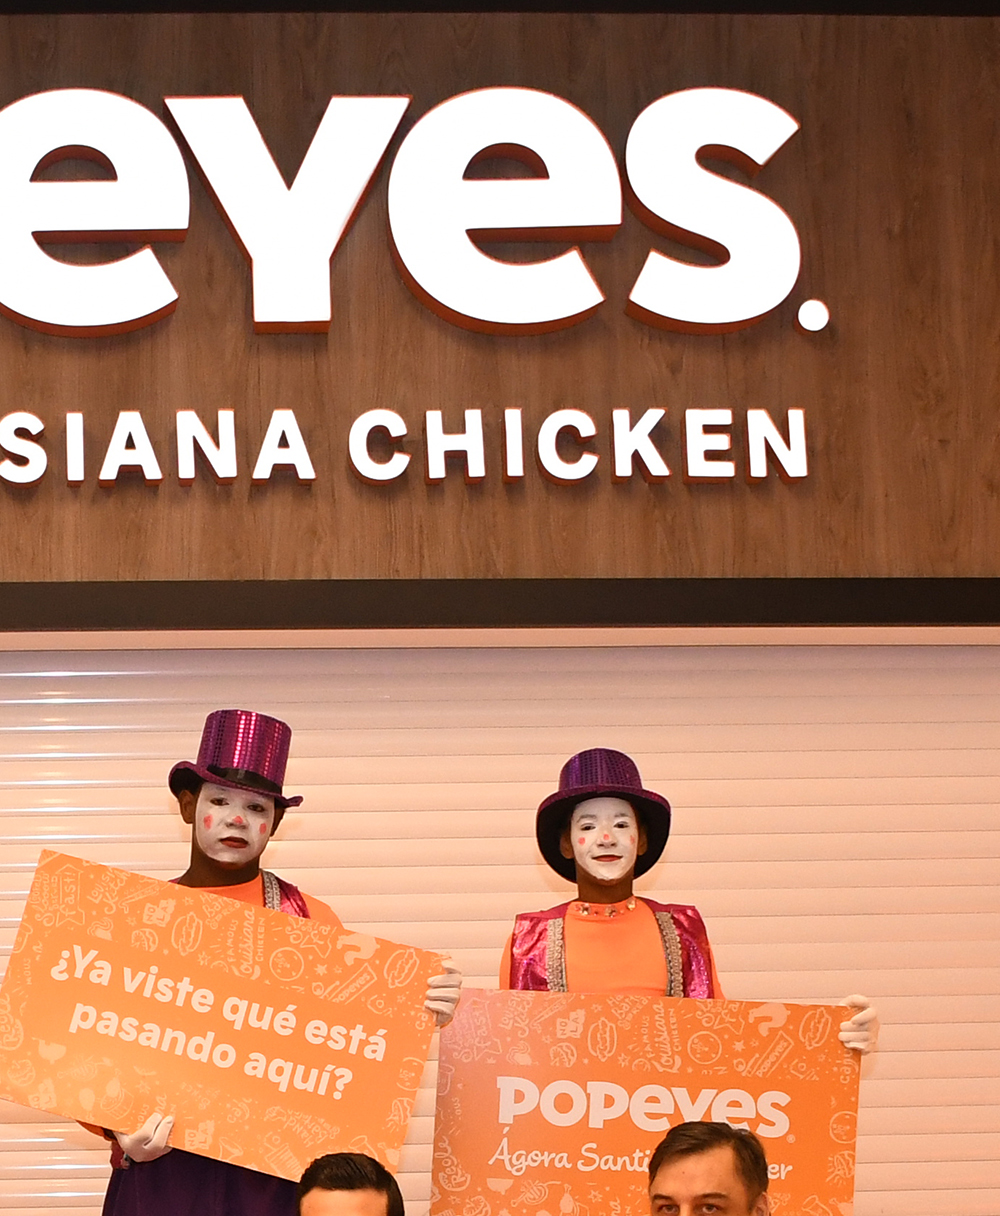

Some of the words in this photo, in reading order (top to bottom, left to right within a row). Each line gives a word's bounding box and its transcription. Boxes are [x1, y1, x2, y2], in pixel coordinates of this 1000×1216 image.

[348, 408, 808, 486] CHICKEN
[50, 945, 112, 986] ¿Ya
[123, 966, 214, 1015] viste
[223, 995, 298, 1036] qué
[304, 1019, 388, 1061] está
[68, 1002, 237, 1070] pasando
[244, 1050, 353, 1101] aquí?
[488, 1127, 573, 1176] Ágora
[577, 1142, 651, 1173] Santi
